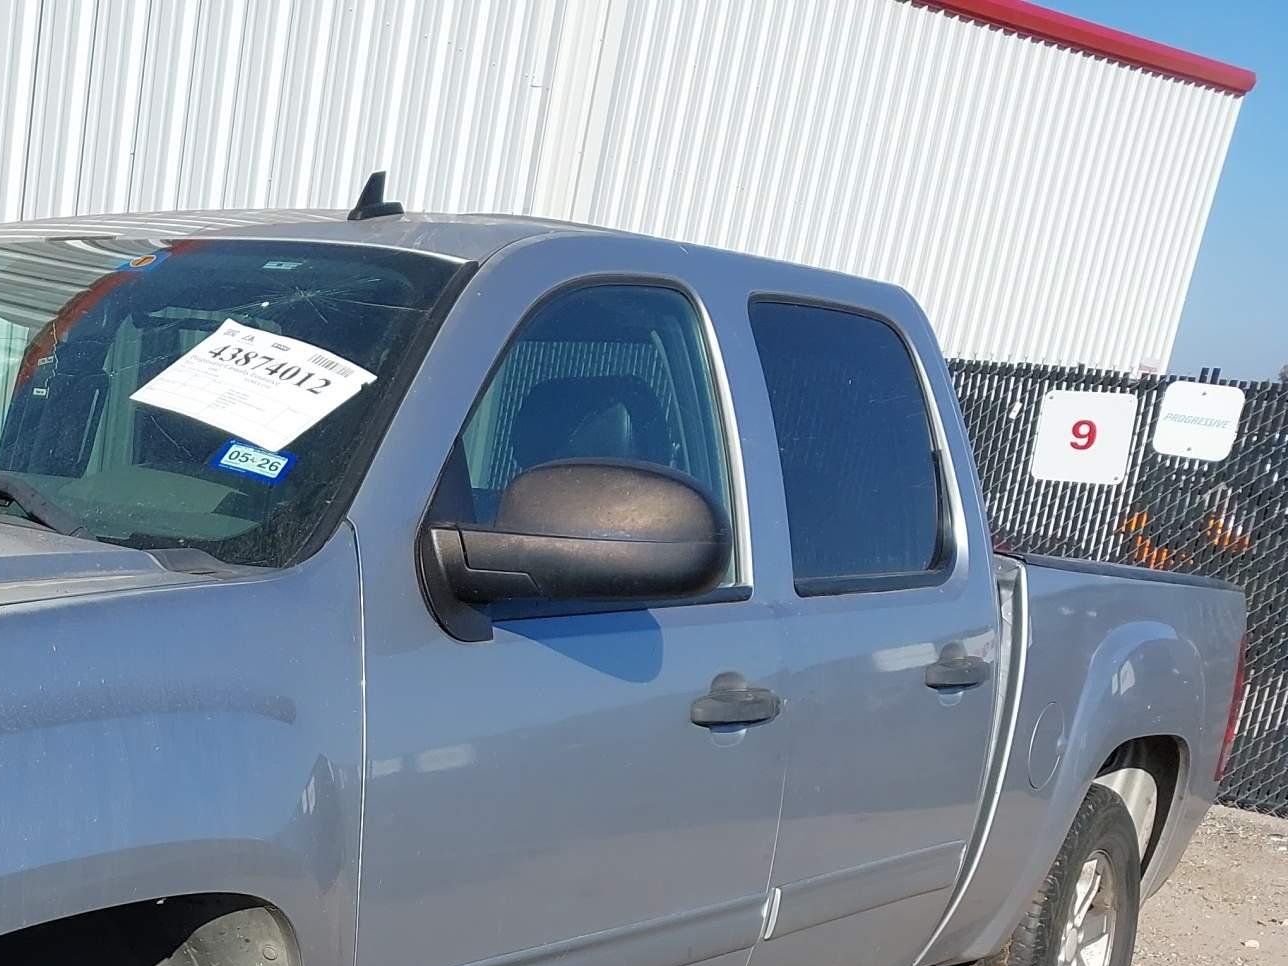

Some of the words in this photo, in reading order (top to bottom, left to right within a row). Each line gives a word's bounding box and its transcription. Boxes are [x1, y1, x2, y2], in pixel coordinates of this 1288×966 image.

[208, 344, 331, 395] 43874012
[1069, 419, 1097, 451] 9
[1163, 412, 1232, 429] PROGRESSIVE
